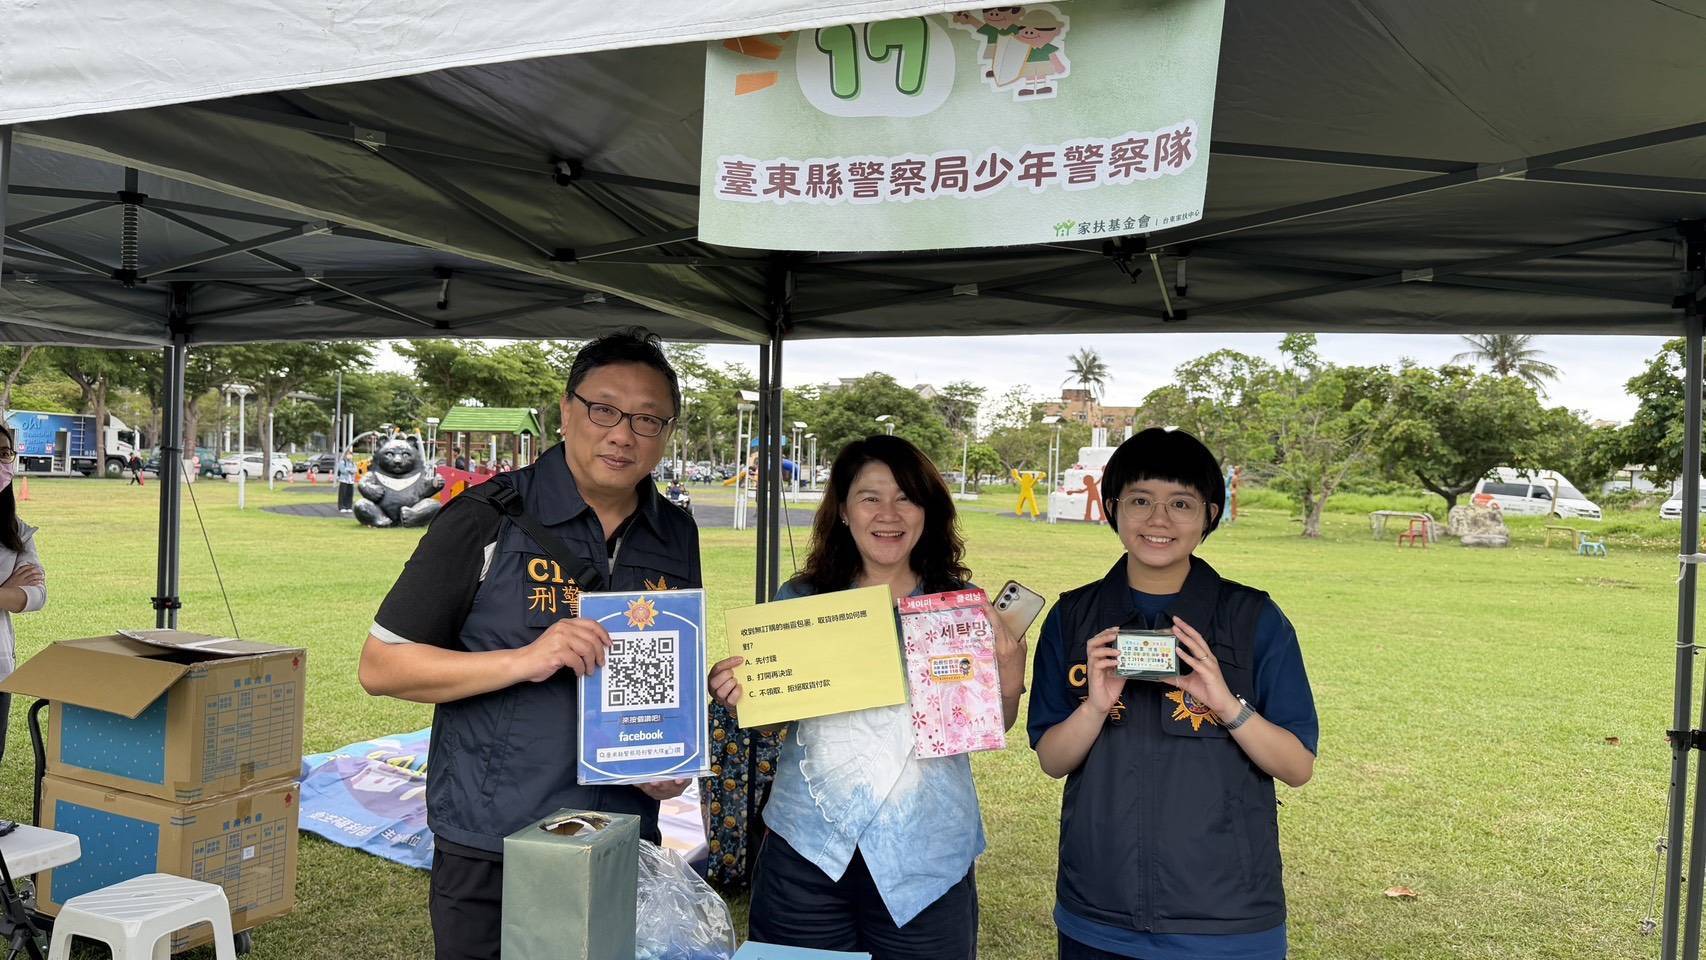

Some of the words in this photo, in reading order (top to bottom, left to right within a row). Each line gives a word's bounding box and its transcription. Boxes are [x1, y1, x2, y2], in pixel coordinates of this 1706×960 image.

[816, 17, 931, 100] 17
[719, 126, 1193, 198] 臺東縣警察局少年警察隊
[1077, 214, 1151, 235] 家扶基金會
[528, 558, 575, 584] CI
[940, 620, 987, 639] 세탁망
[618, 729, 664, 742] facebook
